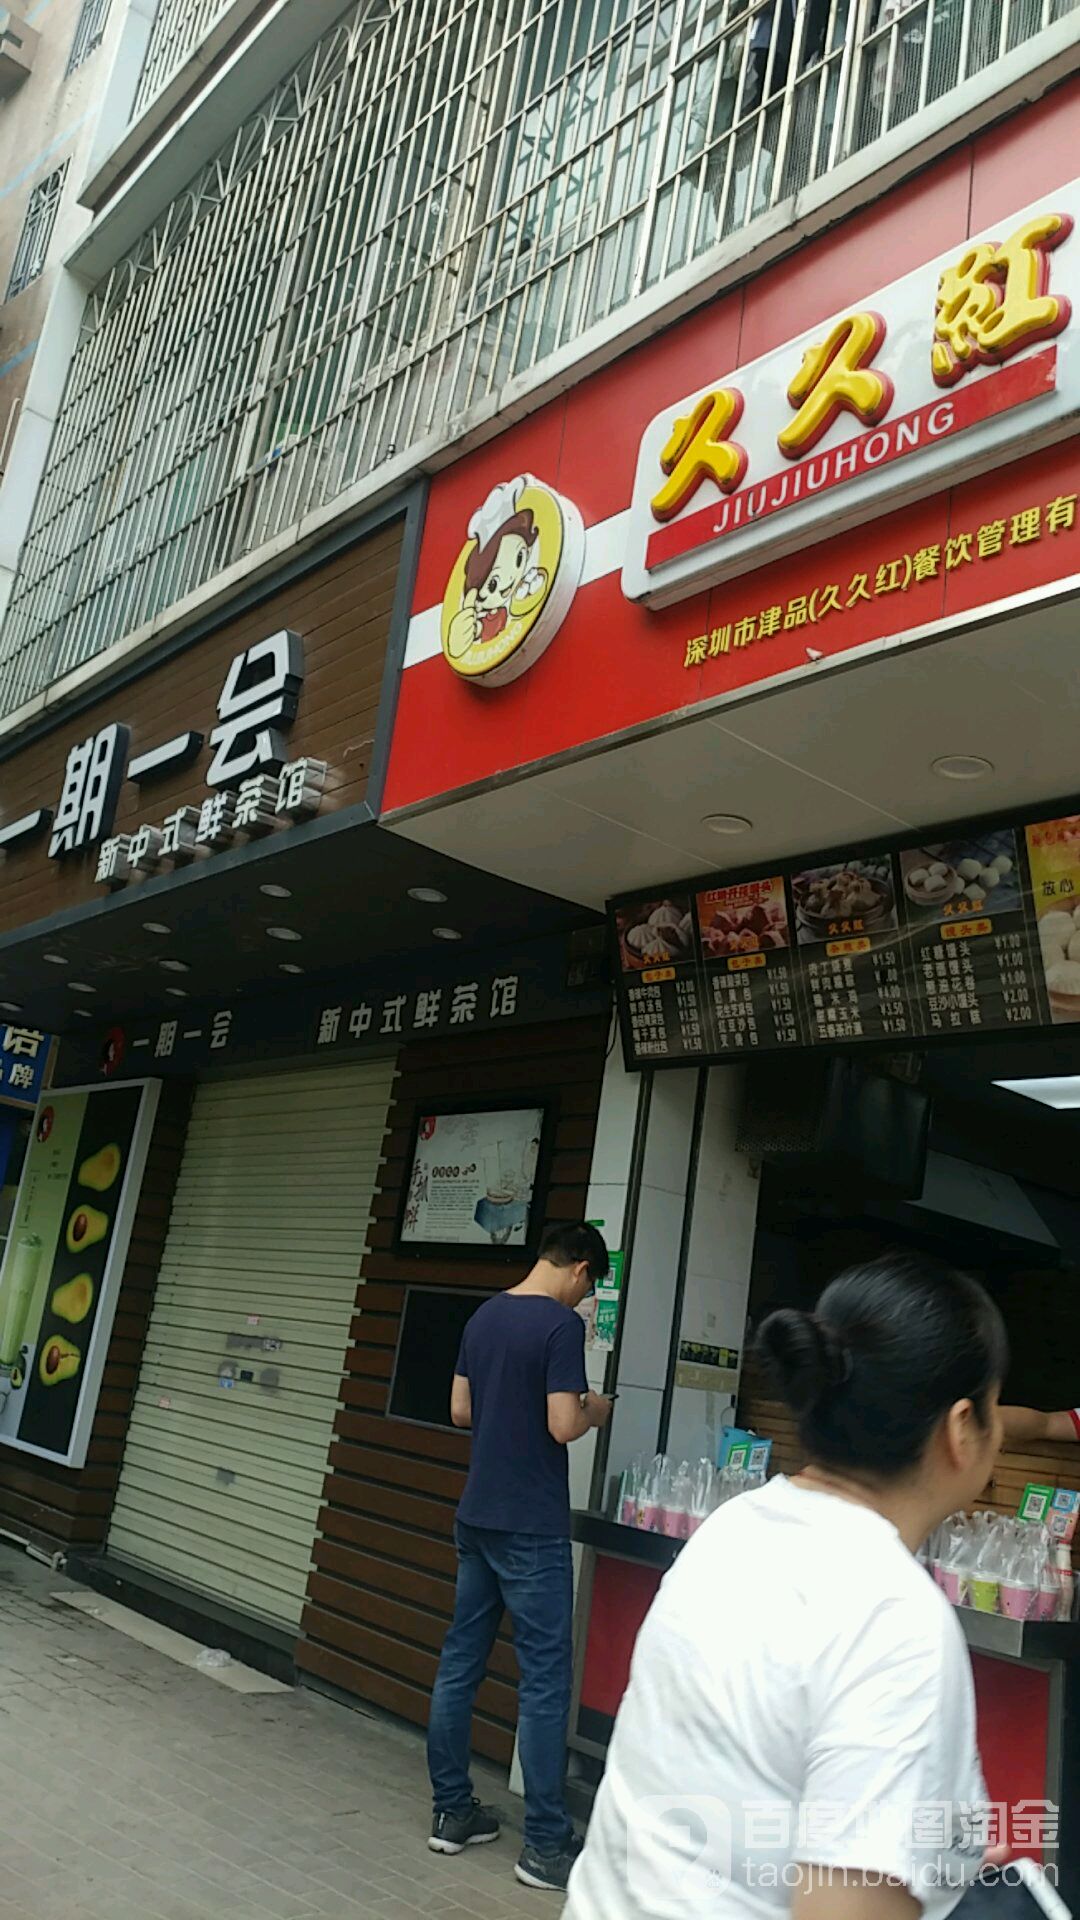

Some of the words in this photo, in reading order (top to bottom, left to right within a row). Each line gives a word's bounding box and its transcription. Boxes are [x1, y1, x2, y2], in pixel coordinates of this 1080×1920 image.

[712, 401, 955, 533] JIUJIUHONG
[0, 629, 295, 858] 一期一会
[95, 756, 312, 884] 新中式鲜茶馆
[920, 941, 970, 962] 红糖馒头
[994, 934, 1020, 949] ¥1.00
[996, 952, 1023, 968] ¥1.00
[874, 968, 897, 983] ¥.00
[1000, 970, 1026, 986] ¥1.00
[316, 975, 520, 1045] 新中式鲜茶馆
[928, 991, 979, 1011] 豆沙小馒头
[1002, 988, 1029, 1004] ¥2.00
[931, 1009, 982, 1029] 马拉糕
[1005, 1005, 1032, 1022] ¥2.00
[132, 1010, 233, 1058] 一期一会
